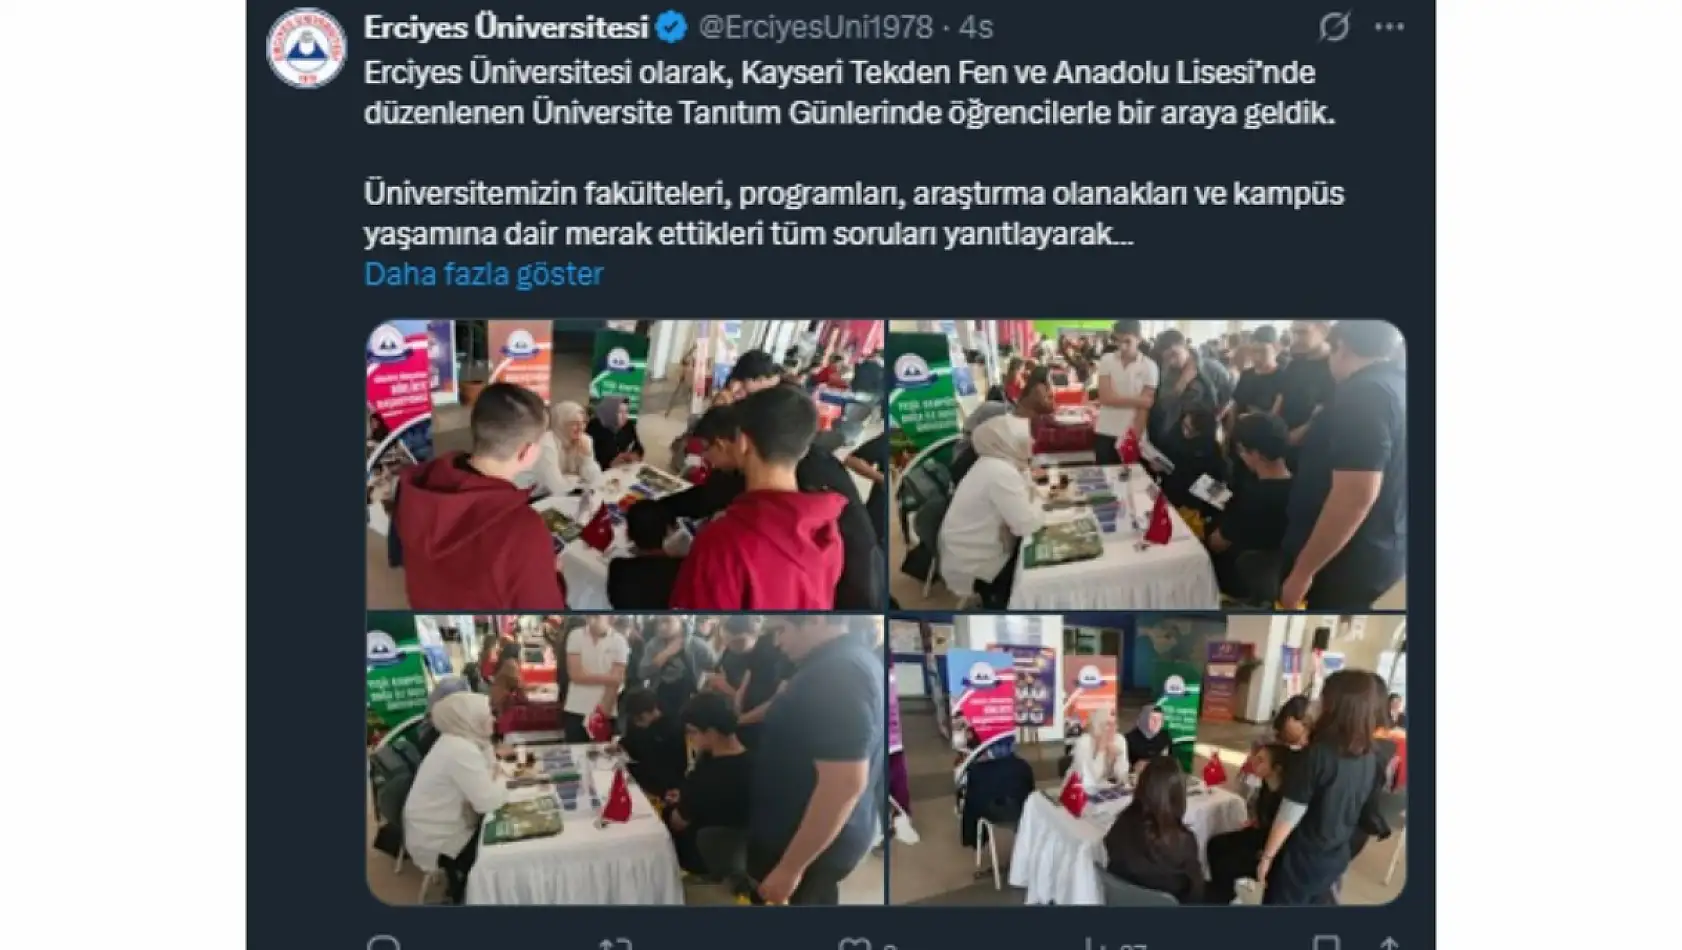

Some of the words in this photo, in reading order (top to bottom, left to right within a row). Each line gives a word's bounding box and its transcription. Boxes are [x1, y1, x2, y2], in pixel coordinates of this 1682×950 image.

[364, 14, 469, 43] Erciyes
[475, 9, 649, 40] Üniversitesi
[700, 15, 932, 43] @ErciyesUni1978
[960, 15, 992, 39] 4s
[364, 58, 463, 89] Erciyes
[470, 55, 632, 84] Üniversitesi
[639, 60, 733, 89] olarak,
[742, 58, 844, 89] Kayseri
[849, 60, 951, 84] Tekden
[959, 60, 1008, 84] Fen
[1014, 65, 1047, 84] ve
[1053, 60, 1169, 84] Anadolu
[364, 99, 524, 125] düzenlenen
[533, 95, 672, 125] Üniversite
[678, 100, 781, 125] Tanıtım
[788, 99, 942, 125] Günlerinde
[948, 97, 1111, 129] öğrencilerle
[1118, 98, 1156, 125] bir
[1161, 105, 1237, 129] araya
[1244, 98, 1336, 129] geldik.
[364, 176, 577, 206] Üniversitemizin
[583, 180, 733, 210] fakülteleri,
[740, 181, 906, 210] programları,
[913, 181, 1046, 210] araştırma
[1053, 181, 1187, 206] olanakları
[1194, 186, 1228, 206] ve
[1234, 181, 1345, 209] kampüs
[363, 226, 498, 250] yaşamına
[504, 220, 559, 245] dair
[566, 221, 653, 245] merak
[658, 220, 763, 245] ettikleri
[769, 220, 826, 245] tüm
[833, 221, 937, 246] soruları
[365, 261, 436, 286] Daha
[444, 261, 509, 286] fazla
[516, 261, 604, 291] göster
